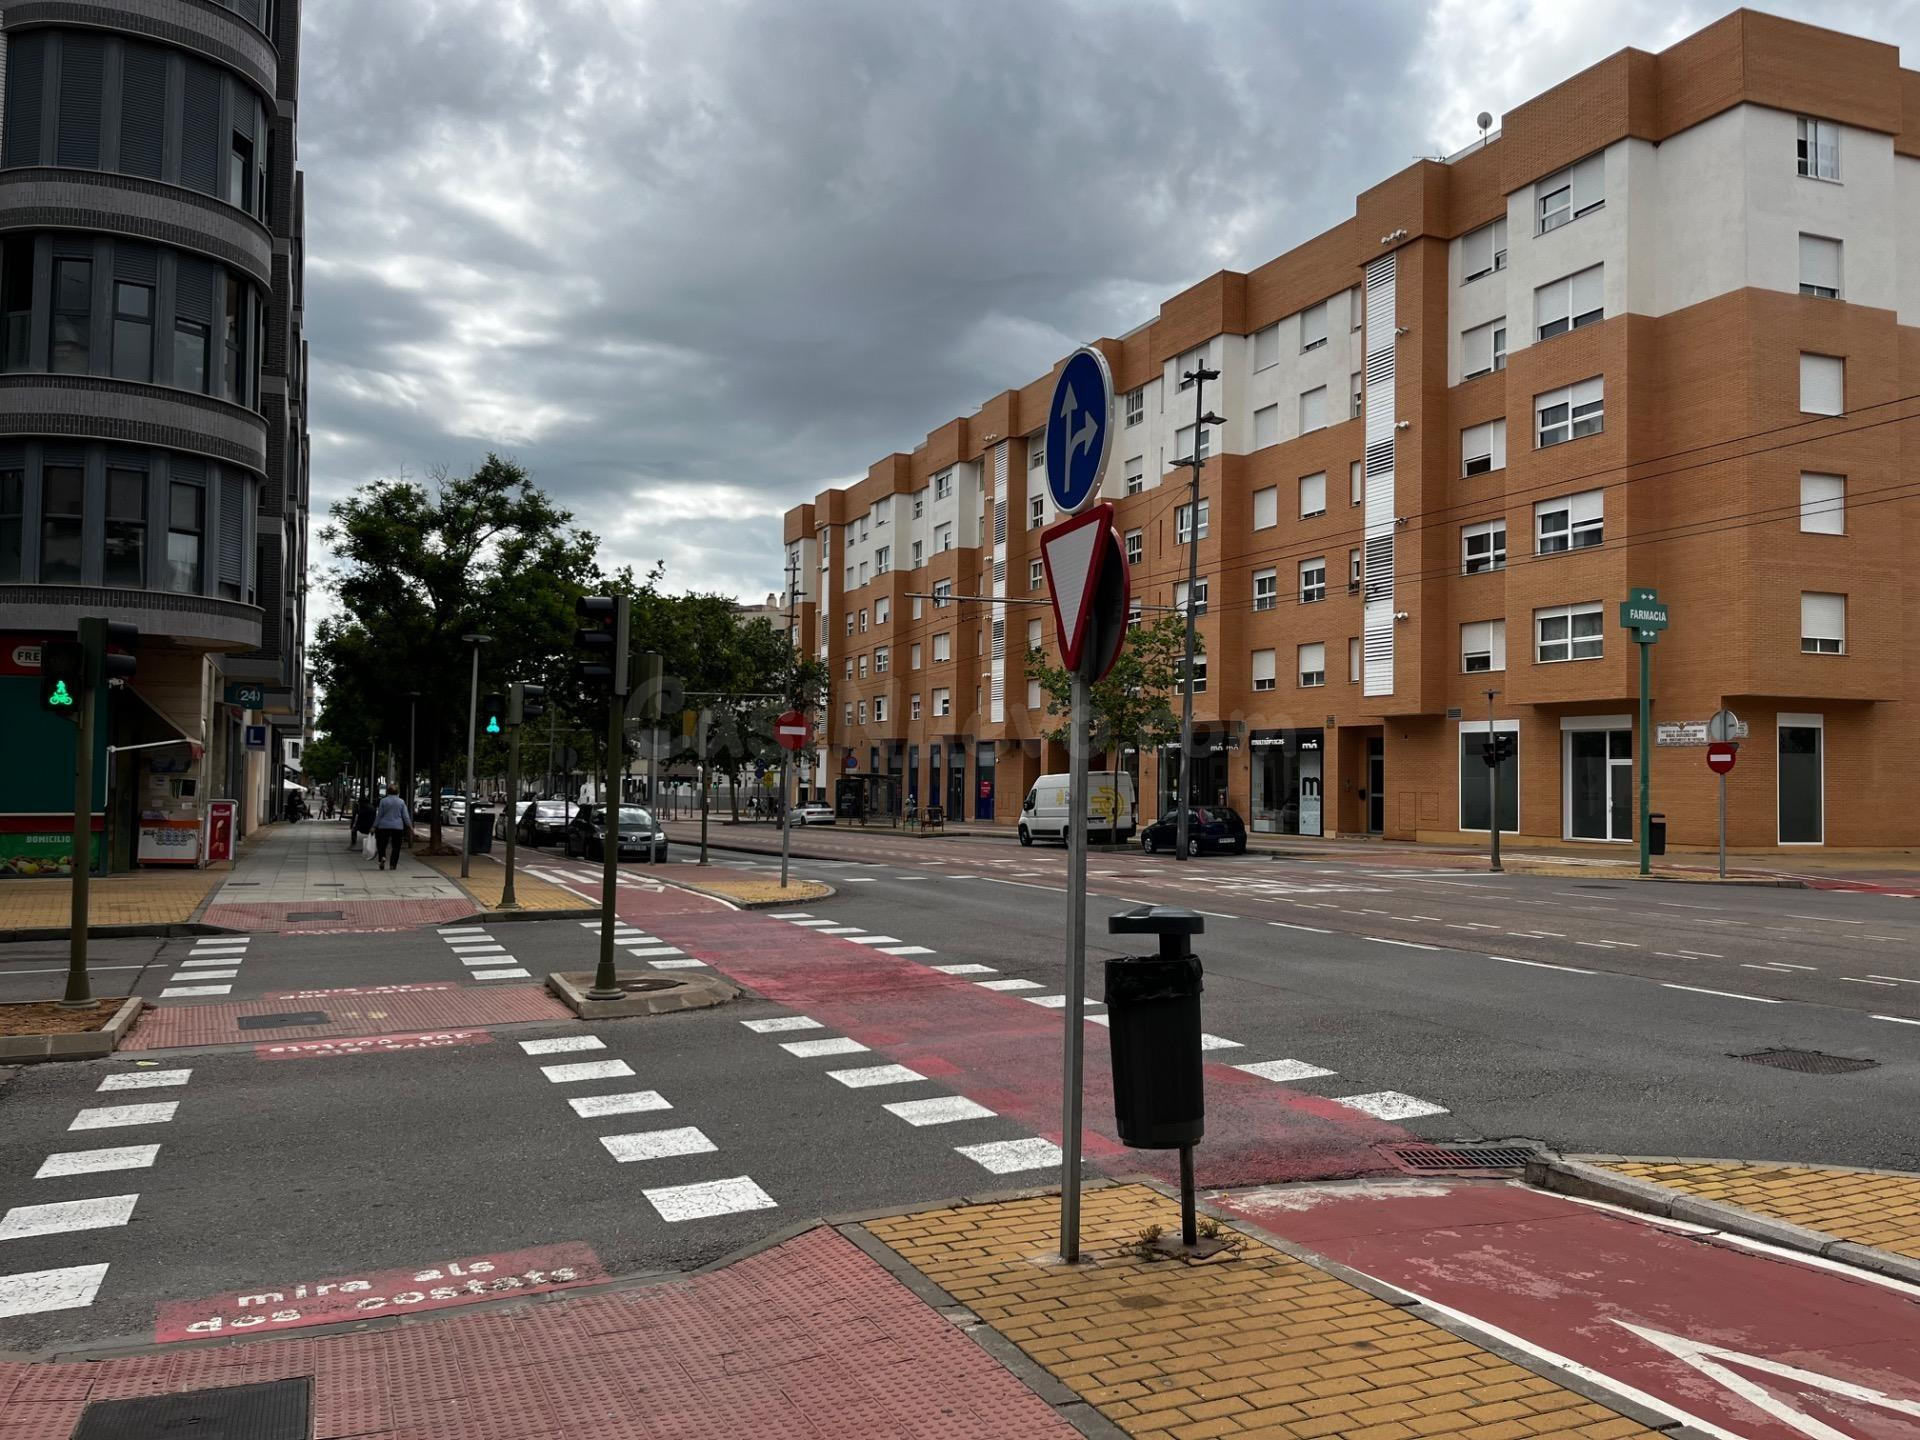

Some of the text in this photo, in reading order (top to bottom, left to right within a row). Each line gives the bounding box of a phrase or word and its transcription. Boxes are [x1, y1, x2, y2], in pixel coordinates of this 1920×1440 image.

[1629, 608, 1667, 622] FARMACIA
[25, 835, 71, 843] DOMICILIO
[238, 1260, 496, 1307] mira als
[186, 1267, 579, 1333] dos costats
